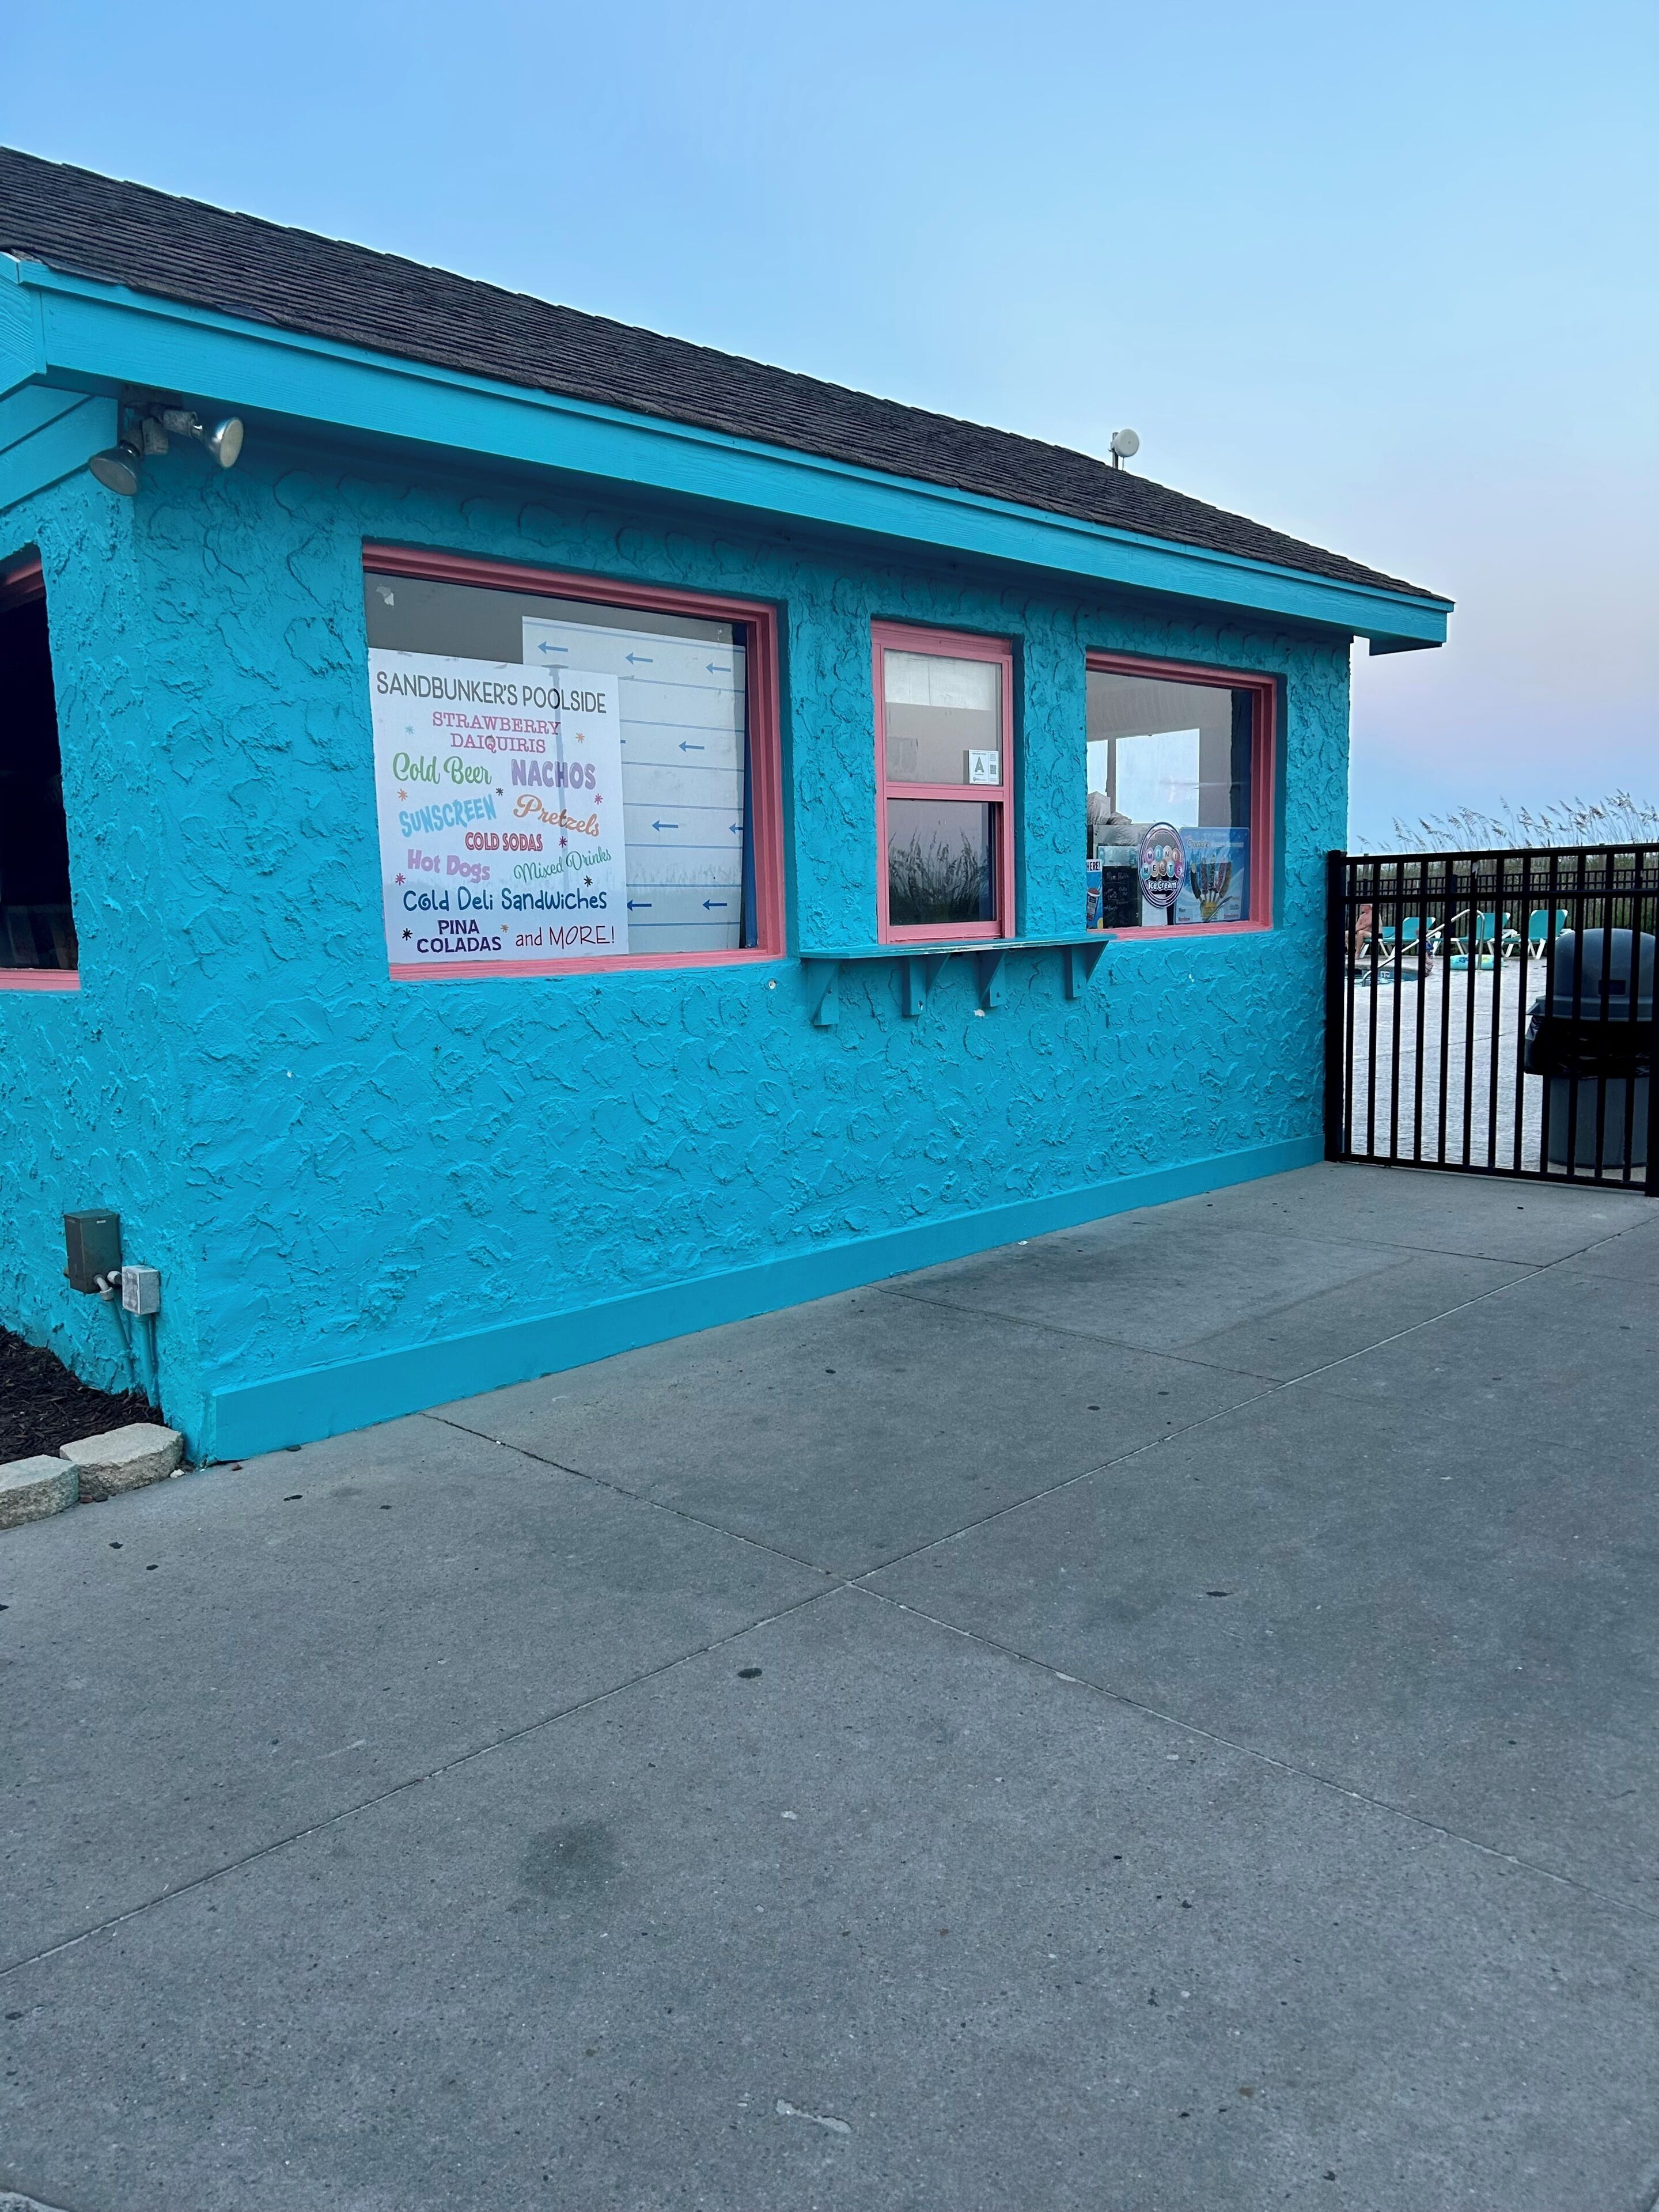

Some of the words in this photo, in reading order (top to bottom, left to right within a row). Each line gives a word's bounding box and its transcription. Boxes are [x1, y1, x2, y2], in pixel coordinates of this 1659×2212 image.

[376, 671, 518, 706] SANDBUNKER'S
[522, 685, 607, 714] POOLSIDE
[432, 711, 561, 735] STRAWBERRY
[450, 733, 546, 753] DAIQUIRIS
[392, 752, 440, 785] Cold
[443, 756, 492, 785] Beer
[511, 759, 596, 790] NACHOS
[975, 756, 984, 772] A
[399, 794, 497, 838] SUNSCREEN
[513, 794, 600, 837] Pretzels
[465, 832, 499, 851] COLD
[502, 833, 543, 852] SODAS
[407, 849, 441, 873] Hot
[446, 855, 490, 884] Dogs
[513, 857, 563, 883] Mixed
[566, 846, 612, 871] Drinks
[1147, 850, 1177, 861] MINI
[1143, 863, 1181, 874] MELTS
[1148, 881, 1157, 890] Ice
[1158, 880, 1177, 890] Cream
[403, 889, 449, 911] Cold
[457, 886, 493, 910] Deli
[437, 919, 480, 935] PINA
[516, 927, 542, 946] and
[550, 925, 615, 949] MORE!
[416, 936, 502, 953] COLADAS
